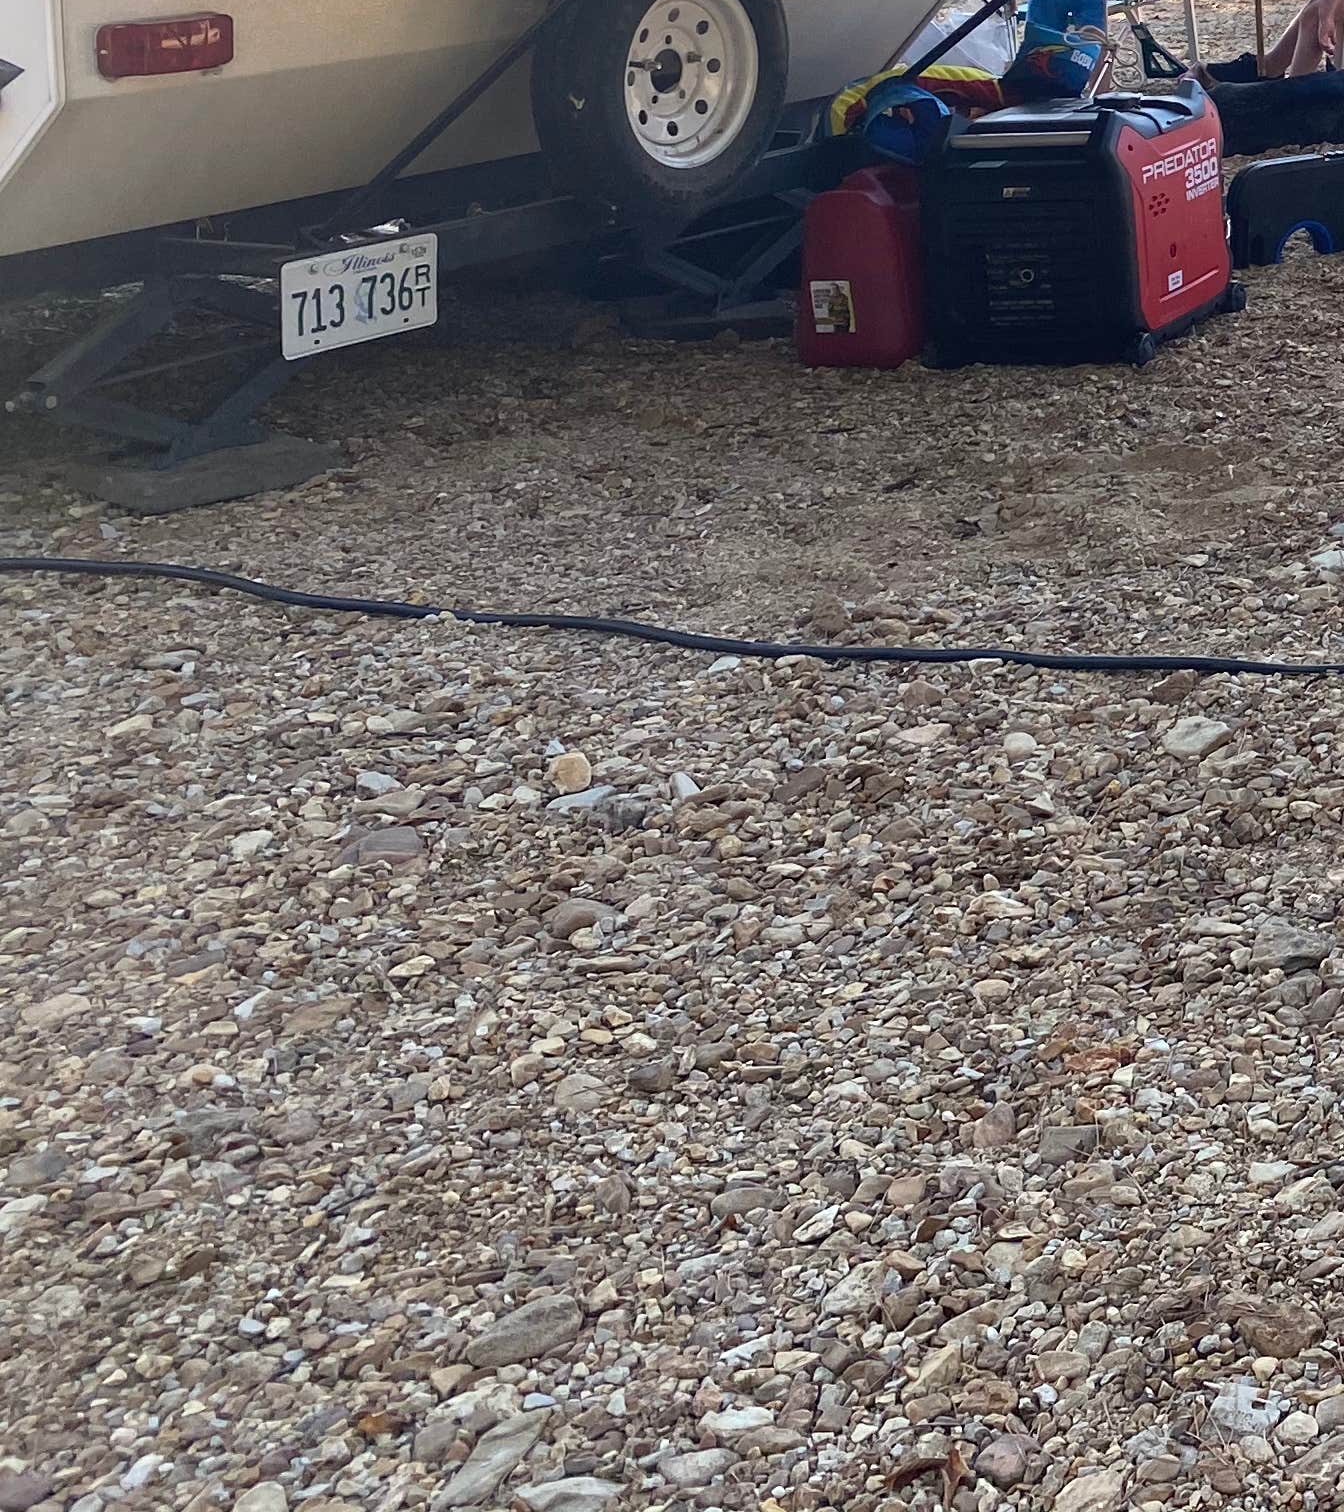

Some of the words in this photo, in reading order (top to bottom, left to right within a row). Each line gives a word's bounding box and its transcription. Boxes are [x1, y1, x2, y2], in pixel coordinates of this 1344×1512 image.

[1141, 137, 1217, 185] PREDATOR
[1184, 156, 1218, 189] 3500
[1185, 176, 1219, 201] INVERTER
[342, 252, 395, 274] Illinois
[291, 284, 345, 337] 713
[361, 267, 413, 320] 736
